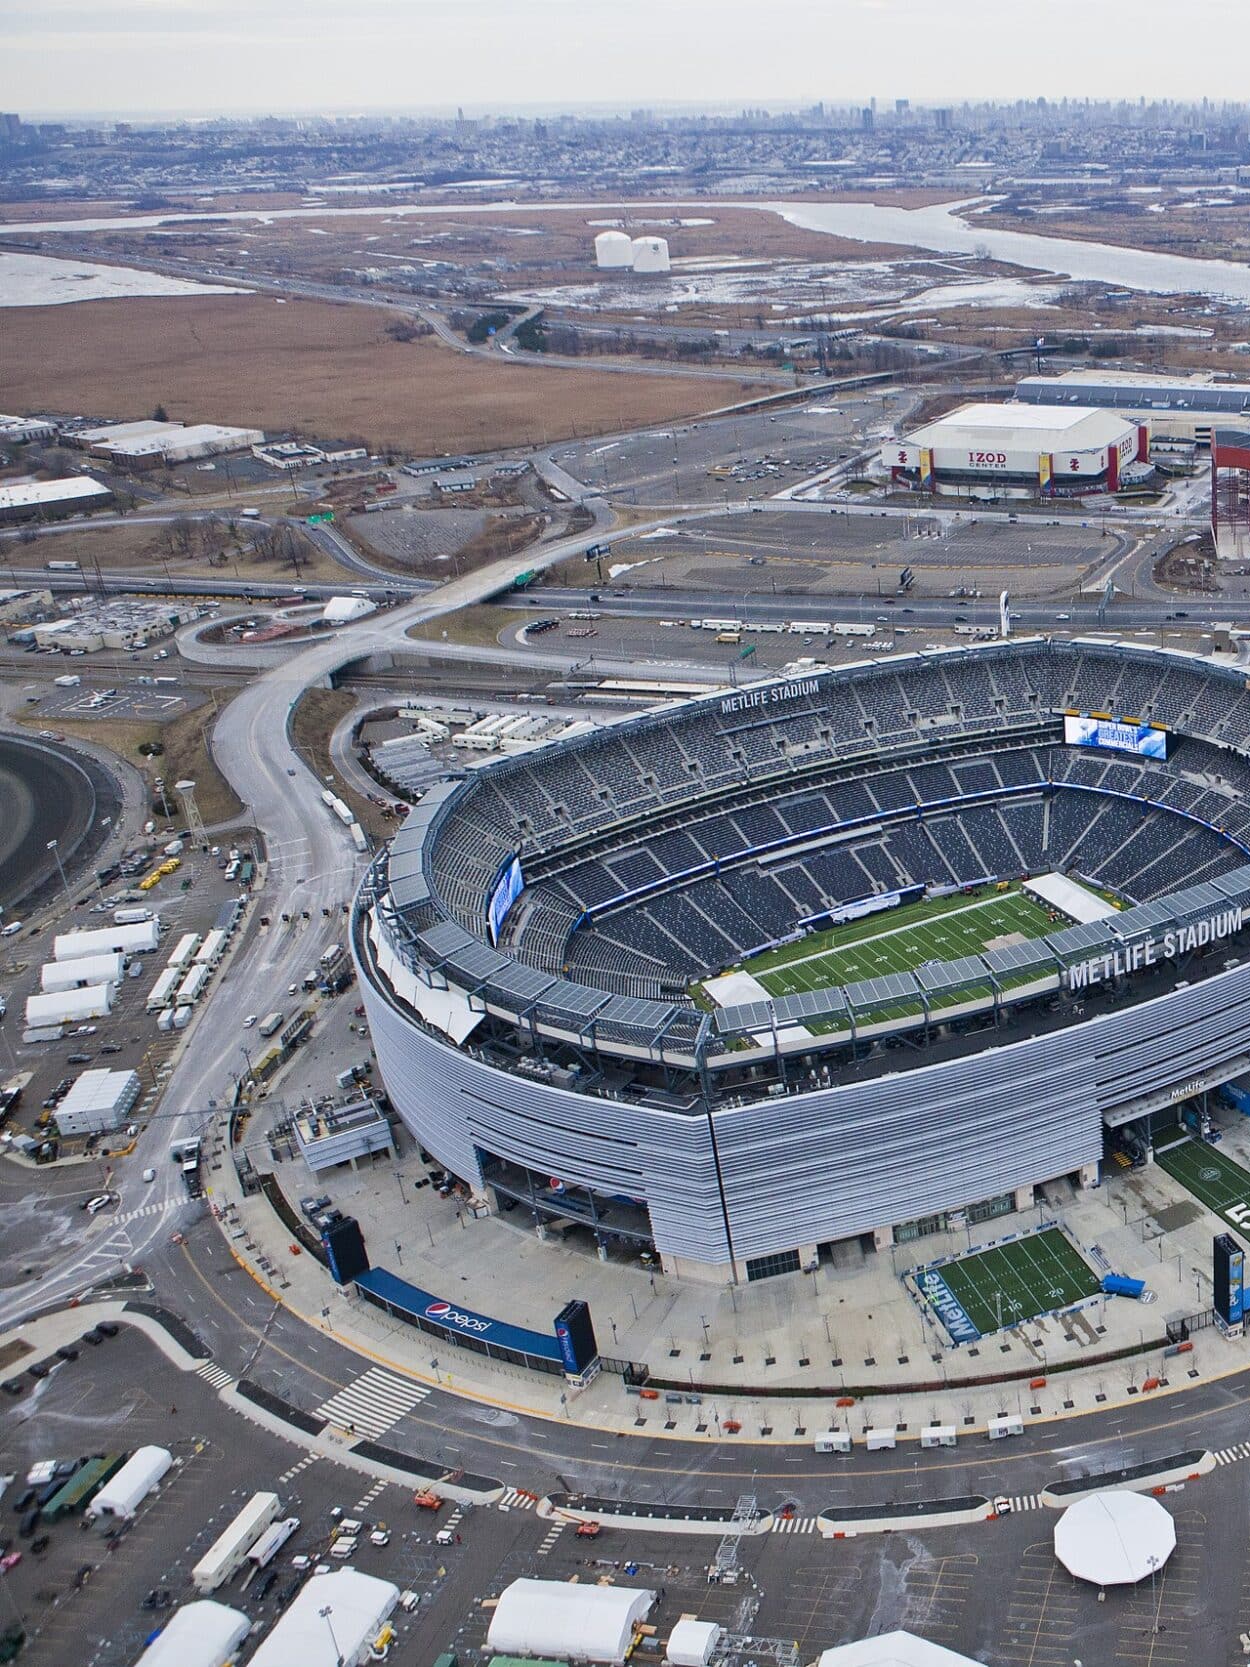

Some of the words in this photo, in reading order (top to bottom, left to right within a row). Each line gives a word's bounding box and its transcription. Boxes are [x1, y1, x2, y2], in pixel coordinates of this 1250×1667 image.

[968, 451, 1007, 463] IZOD
[721, 690, 769, 714] METLIFE
[770, 680, 820, 702] STADIUM
[1069, 939, 1157, 990] METLIFE
[1163, 907, 1243, 958] STADIUM
[1171, 1080, 1206, 1099] MetLife
[922, 1273, 977, 1337] MetLife
[440, 1311, 493, 1332] pepsi
